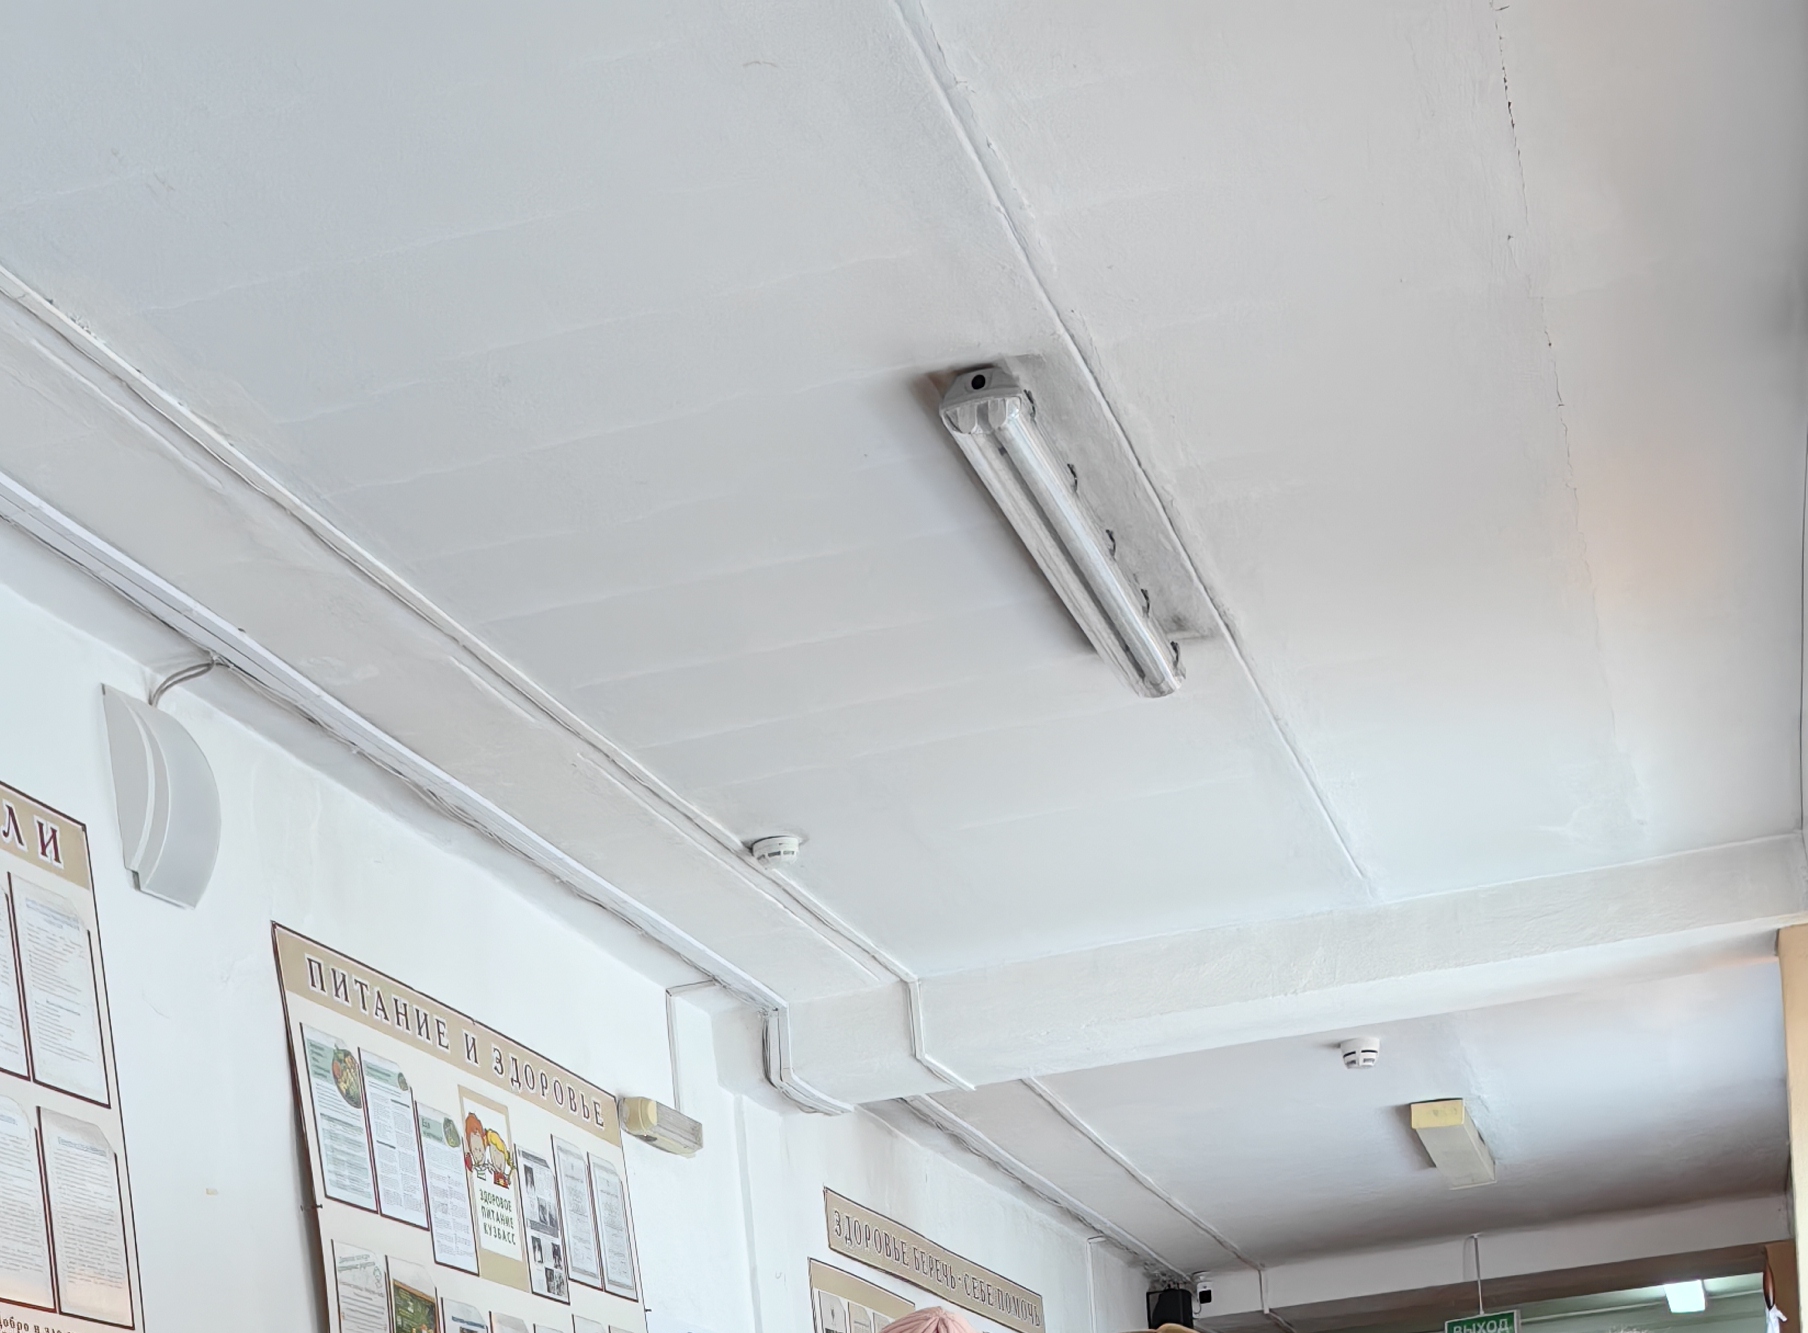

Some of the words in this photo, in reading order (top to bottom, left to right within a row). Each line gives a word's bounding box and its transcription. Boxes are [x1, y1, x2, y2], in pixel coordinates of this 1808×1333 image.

[306, 957, 450, 1050] ПИТАНИЕ
[464, 1032, 479, 1065] И
[492, 1047, 605, 1127] ЗДОРОВЬЕ
[479, 1188, 512, 1213] ЗДОРОВОЕ
[481, 1205, 514, 1230] ПИТАНИЕ
[483, 1222, 516, 1246] КУЗБАСС
[834, 1210, 909, 1267] ЗДОРОВЬЕ
[912, 1246, 957, 1290] БЕРЕЧЬ
[963, 1273, 995, 1307] СЕБЕ
[996, 1288, 1042, 1328] ПОМОЧЬ
